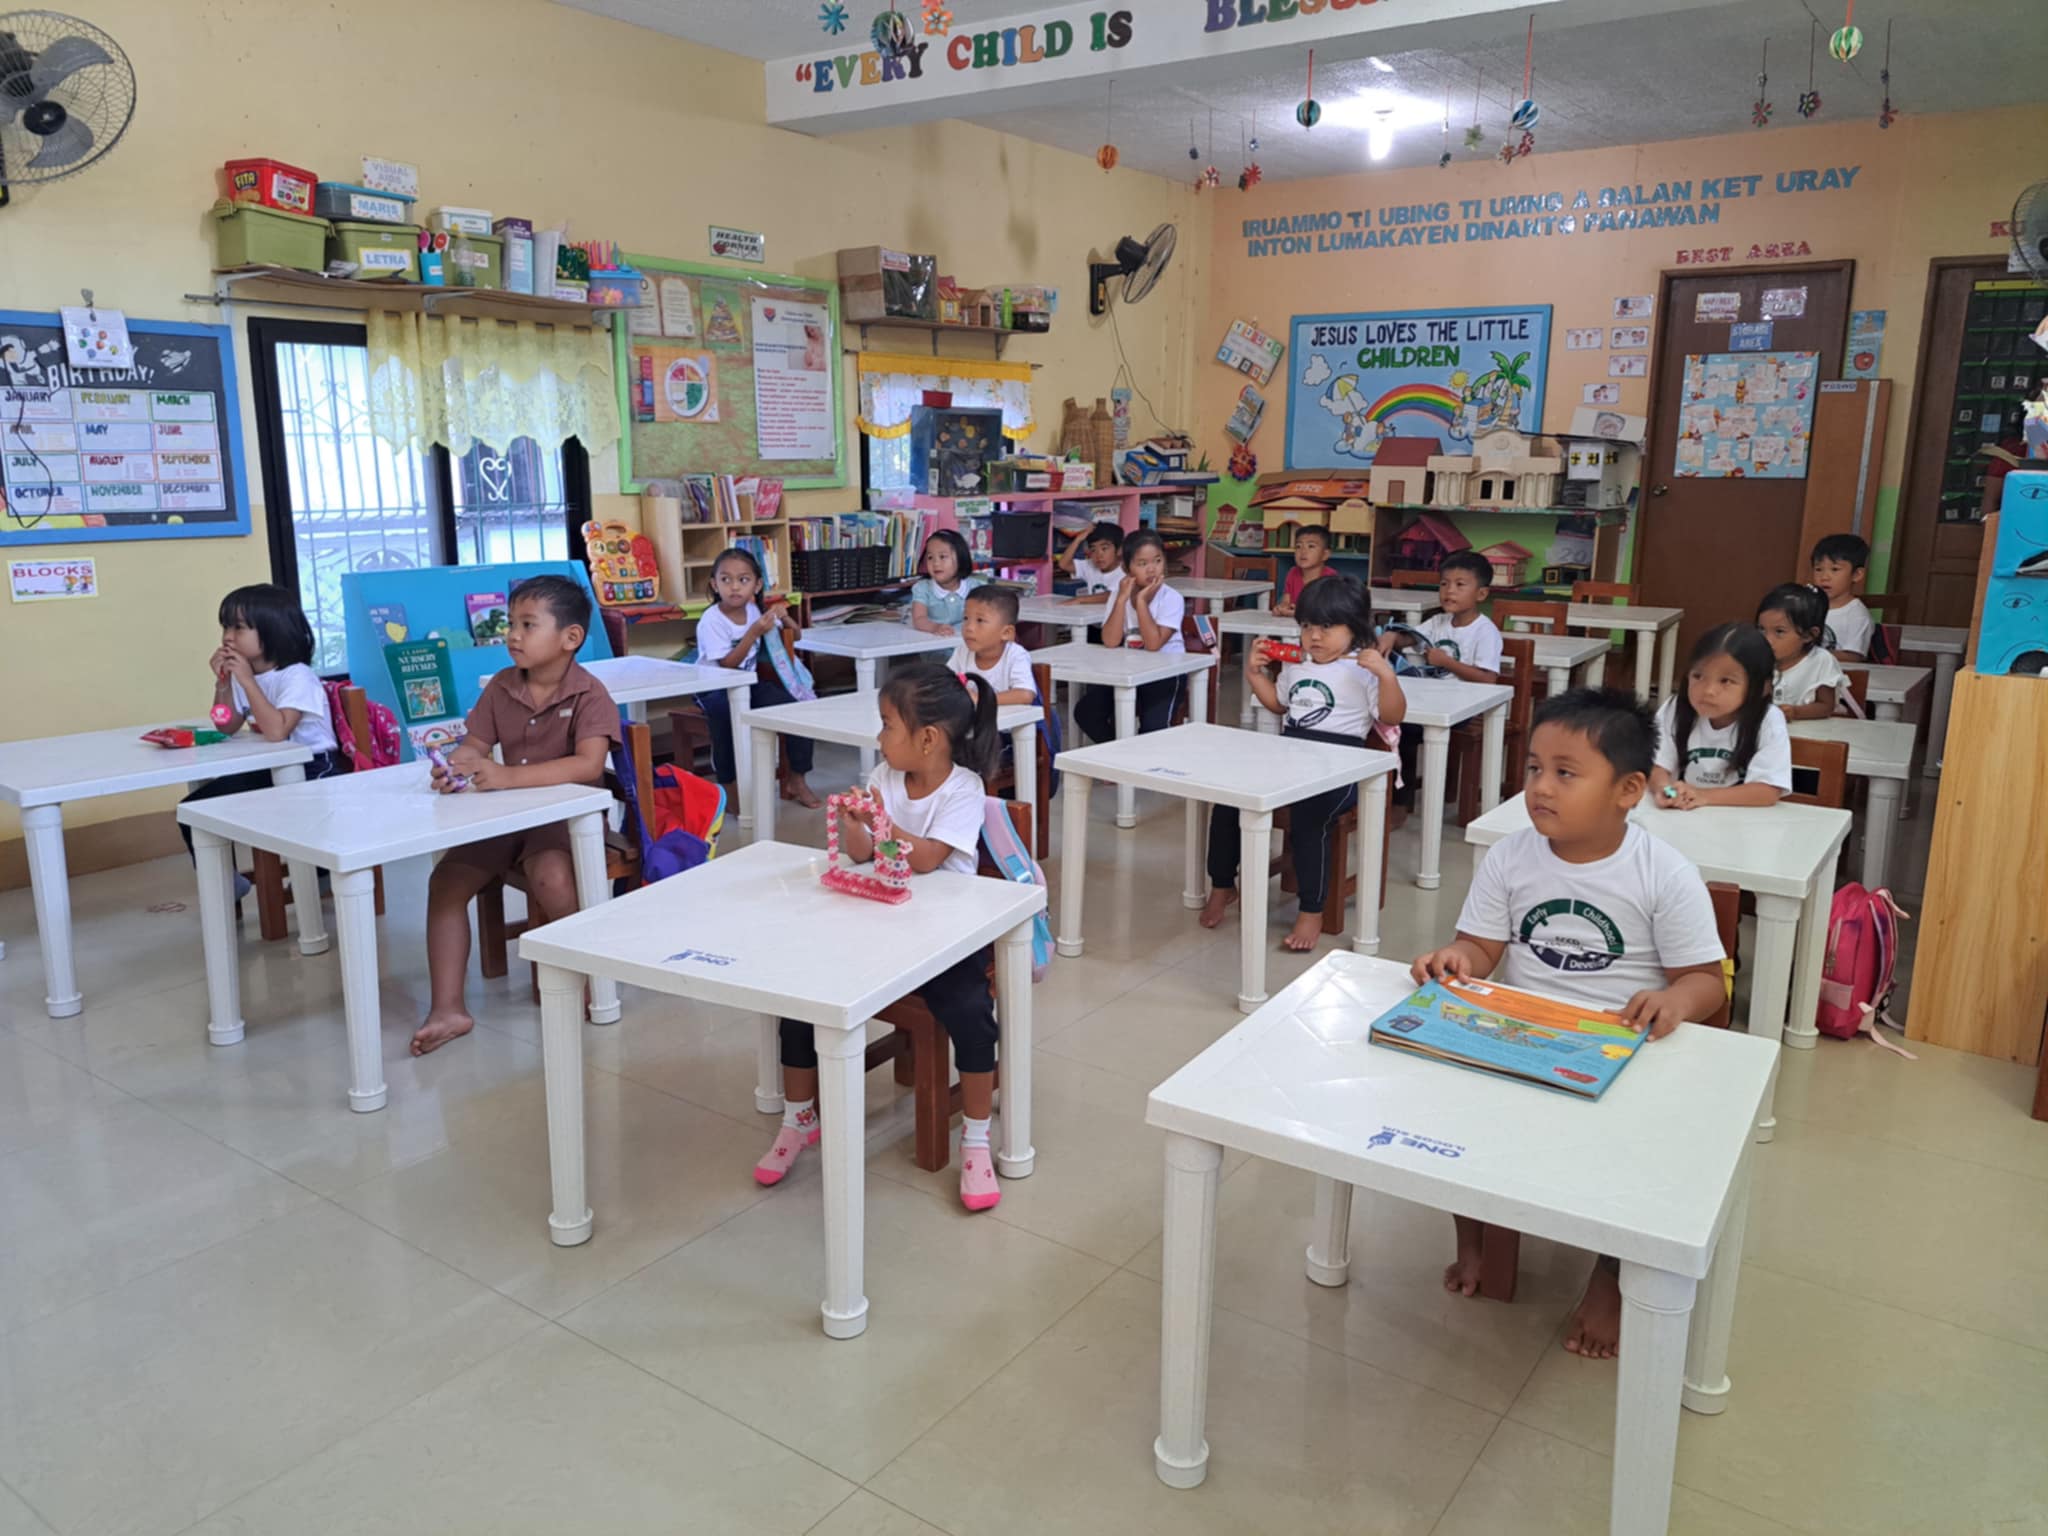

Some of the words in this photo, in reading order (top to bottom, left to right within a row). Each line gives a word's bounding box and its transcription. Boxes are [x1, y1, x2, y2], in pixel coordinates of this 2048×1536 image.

[946, 20, 1073, 71] CHILD
[1090, 10, 1133, 51] IS
[234, 171, 257, 189] FITA
[1346, 209, 1371, 228] TI
[1378, 202, 1450, 226] UBING
[1459, 200, 1482, 219] TI
[1572, 189, 1591, 210] A
[1700, 175, 1763, 200] KET
[1775, 166, 1861, 193] URAY
[715, 231, 759, 244] HEALTH
[1247, 236, 1311, 257] INTON
[1317, 224, 1459, 252] LUMAKAYEN
[364, 252, 407, 266] LETRA
[1311, 326, 1358, 346] JESUS
[1365, 321, 1417, 344] LOVES
[1426, 319, 1458, 342] THE
[1466, 318, 1530, 342] LITTLE
[1356, 345, 1461, 369] CHILDREN
[5, 390, 51, 403] JANUARY
[156, 394, 191, 405] MARCH
[12, 457, 37, 467] JULY
[162, 484, 210, 494] DECEMBER
[13, 565, 92, 578] BLOCKS
[397, 653, 436, 665] NURSERY
[401, 663, 438, 673] RHYMES
[1527, 907, 1549, 925] Early
[1582, 907, 1617, 946] Childhood
[1399, 1136, 1461, 1158] ONE
